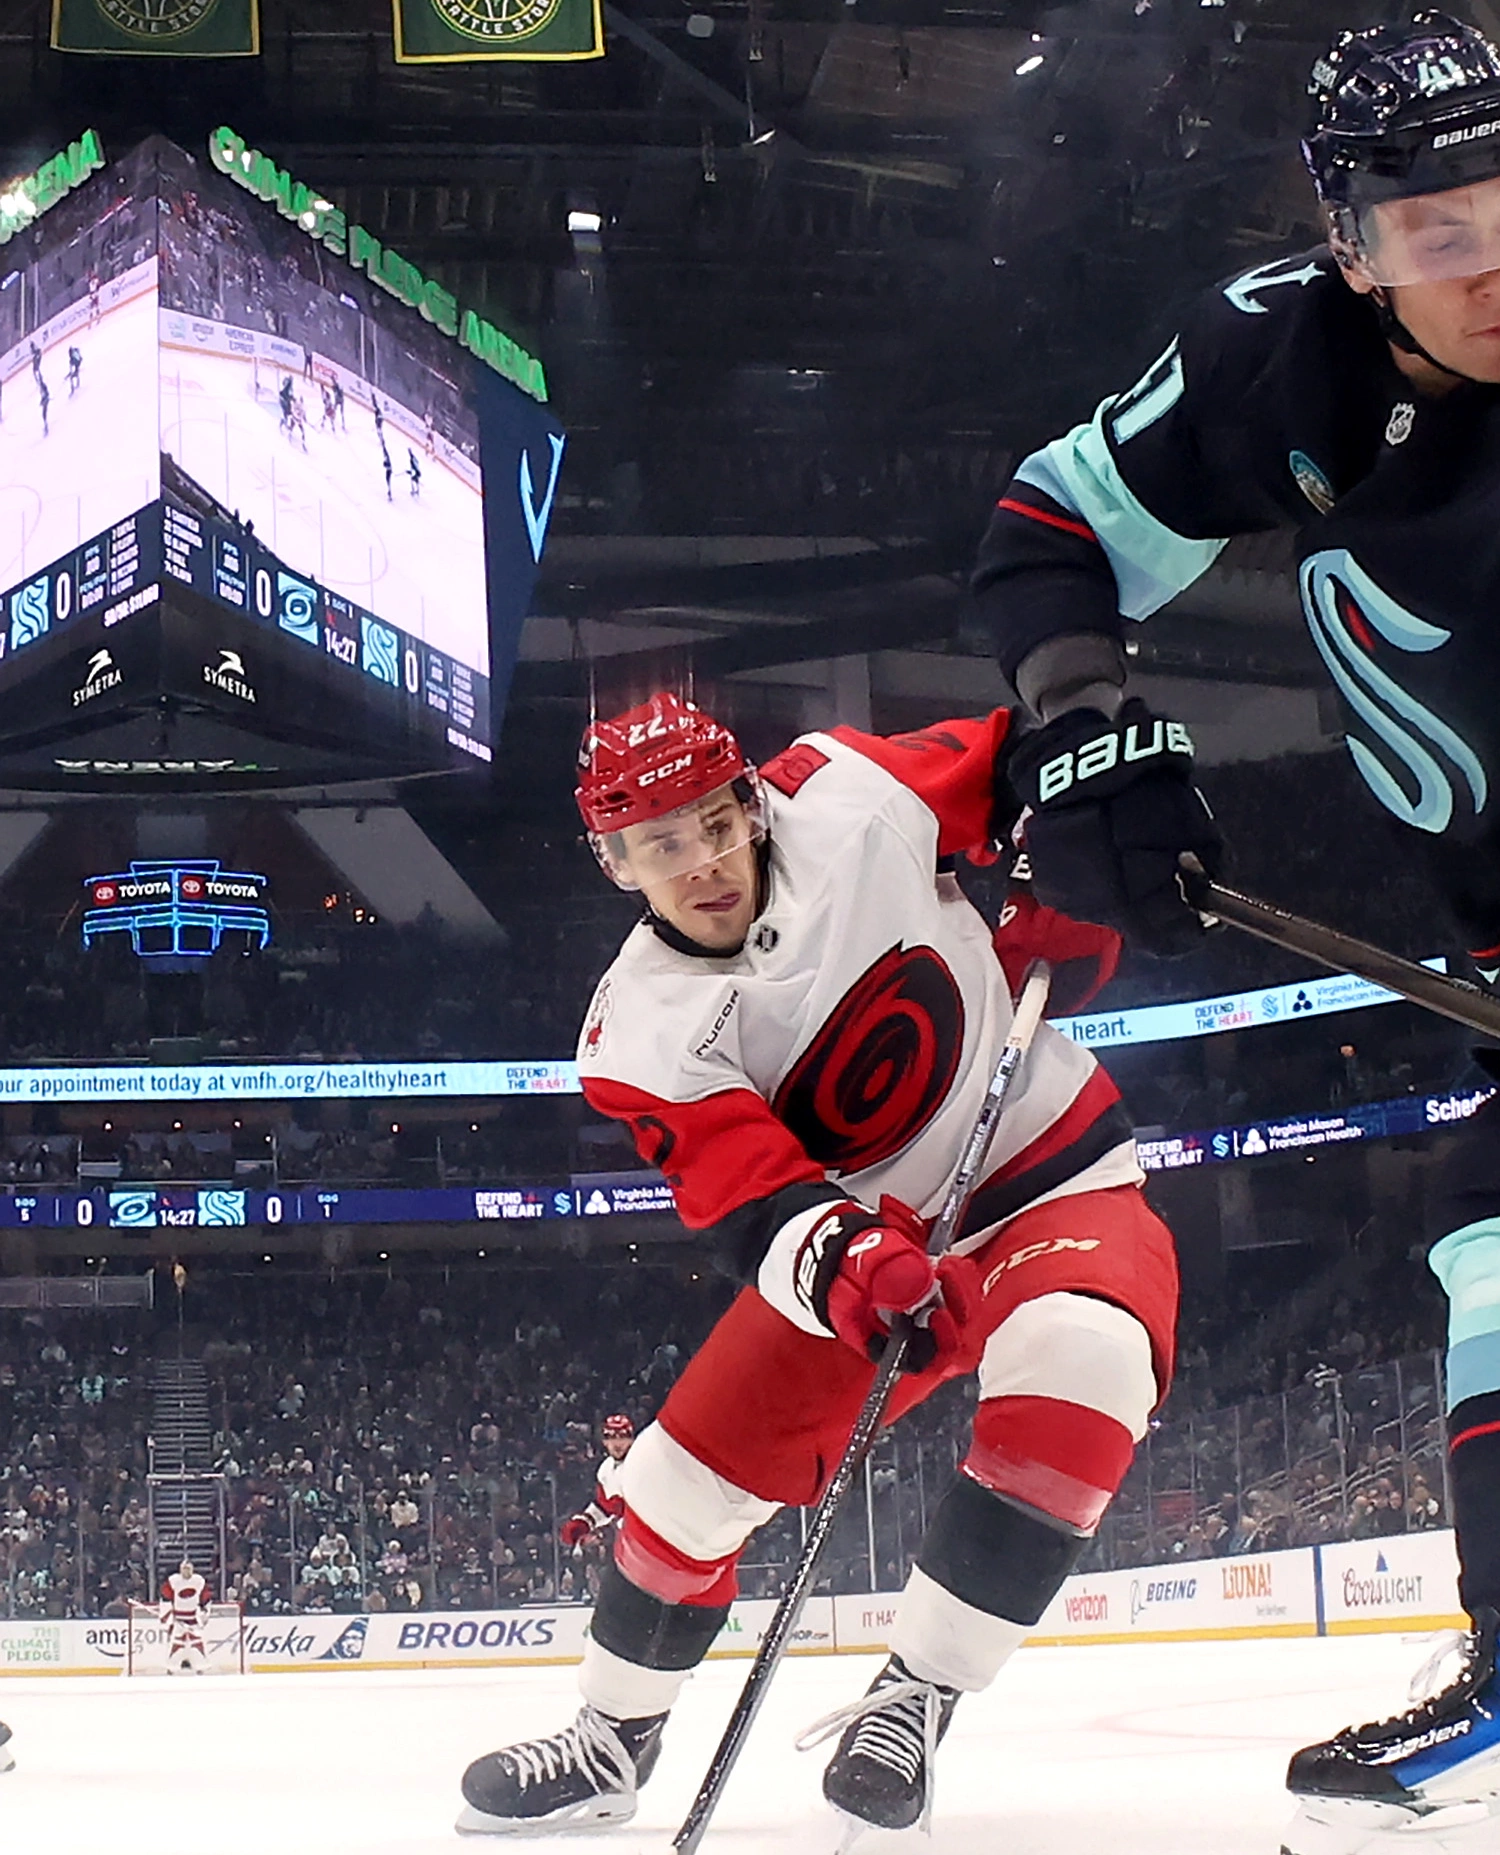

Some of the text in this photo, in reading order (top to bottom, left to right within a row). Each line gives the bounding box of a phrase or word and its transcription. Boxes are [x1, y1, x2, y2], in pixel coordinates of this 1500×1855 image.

[57, 572, 71, 620] 0
[256, 569, 271, 617] 0
[324, 627, 357, 665] 14:27
[405, 650, 418, 693] 0
[73, 670, 122, 706] SYMETRA
[204, 667, 256, 702] SYMETRA
[638, 753, 693, 787] CCM
[119, 881, 171, 898] TOYOTA
[206, 882, 258, 899] TOYOTA
[1195, 1001, 1235, 1019] DEFEND
[1196, 1011, 1253, 1031] THE HEART
[696, 989, 739, 1056] NUCOR
[1073, 1017, 1133, 1042] heart.
[30, 1073, 145, 1096] appointment
[151, 1073, 201, 1095] today
[208, 1074, 226, 1091] at
[231, 1069, 447, 1093] vmfh.org/healthyheart
[507, 1067, 549, 1079] DEFEND
[508, 1078, 568, 1091] THE HEART
[1268, 1117, 1345, 1140] Virginia Mason
[1269, 1126, 1361, 1150] Franciscan Health
[1137, 1138, 1184, 1155] DEFEND
[1138, 1148, 1204, 1170] THE HEART
[475, 1192, 523, 1206] DEFEND
[611, 1188, 652, 1202] Virginia
[613, 1200, 671, 1212] Franciscan
[78, 1199, 93, 1226] 0
[160, 1209, 196, 1227] 14:27
[267, 1197, 282, 1224] 0
[476, 1203, 544, 1220] THE HEART
[1147, 1578, 1197, 1603] BOEING
[1384, 1575, 1423, 1604] LIGHT
[1065, 1587, 1109, 1622] verizon
[1, 1639, 61, 1650] CLIMATE
[86, 1624, 172, 1644] amazon
[209, 1624, 316, 1655] Alaska
[398, 1618, 557, 1649] BROOKS
[7, 1651, 61, 1662] PLEDGE
